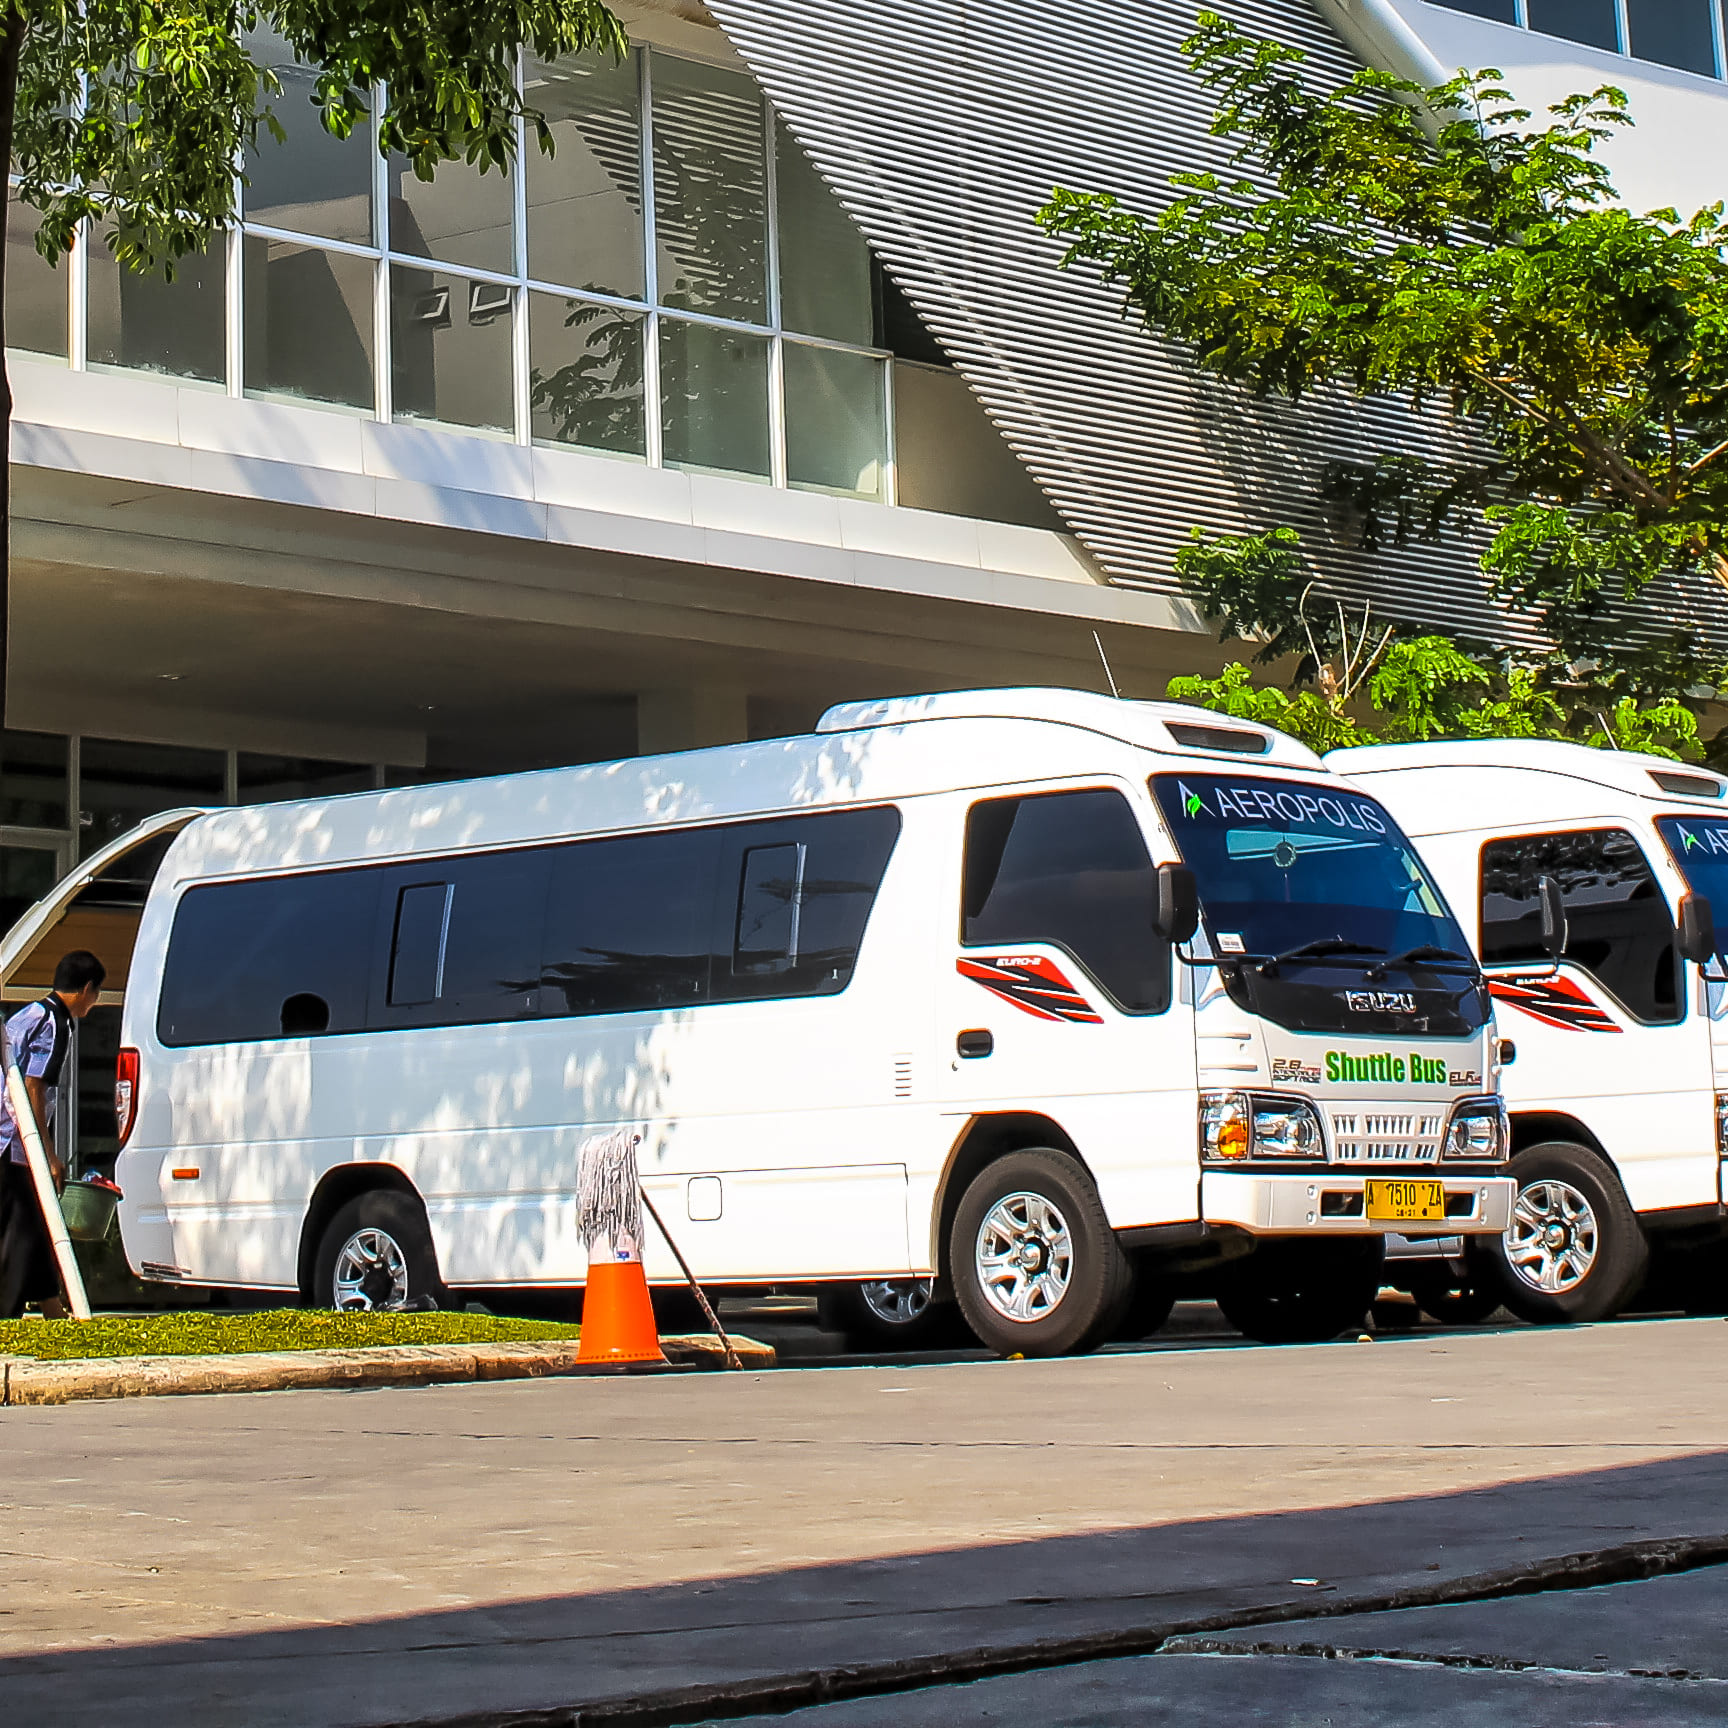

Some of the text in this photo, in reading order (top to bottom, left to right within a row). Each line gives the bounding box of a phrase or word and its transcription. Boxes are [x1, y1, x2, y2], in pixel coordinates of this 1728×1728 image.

[1215, 787, 1386, 834] AEROPOLIS
[1345, 990, 1417, 1013] ISUZU
[1325, 1050, 1447, 1084] Shuttle Bus
[1367, 1182, 1442, 1207] A 7510 ZA
